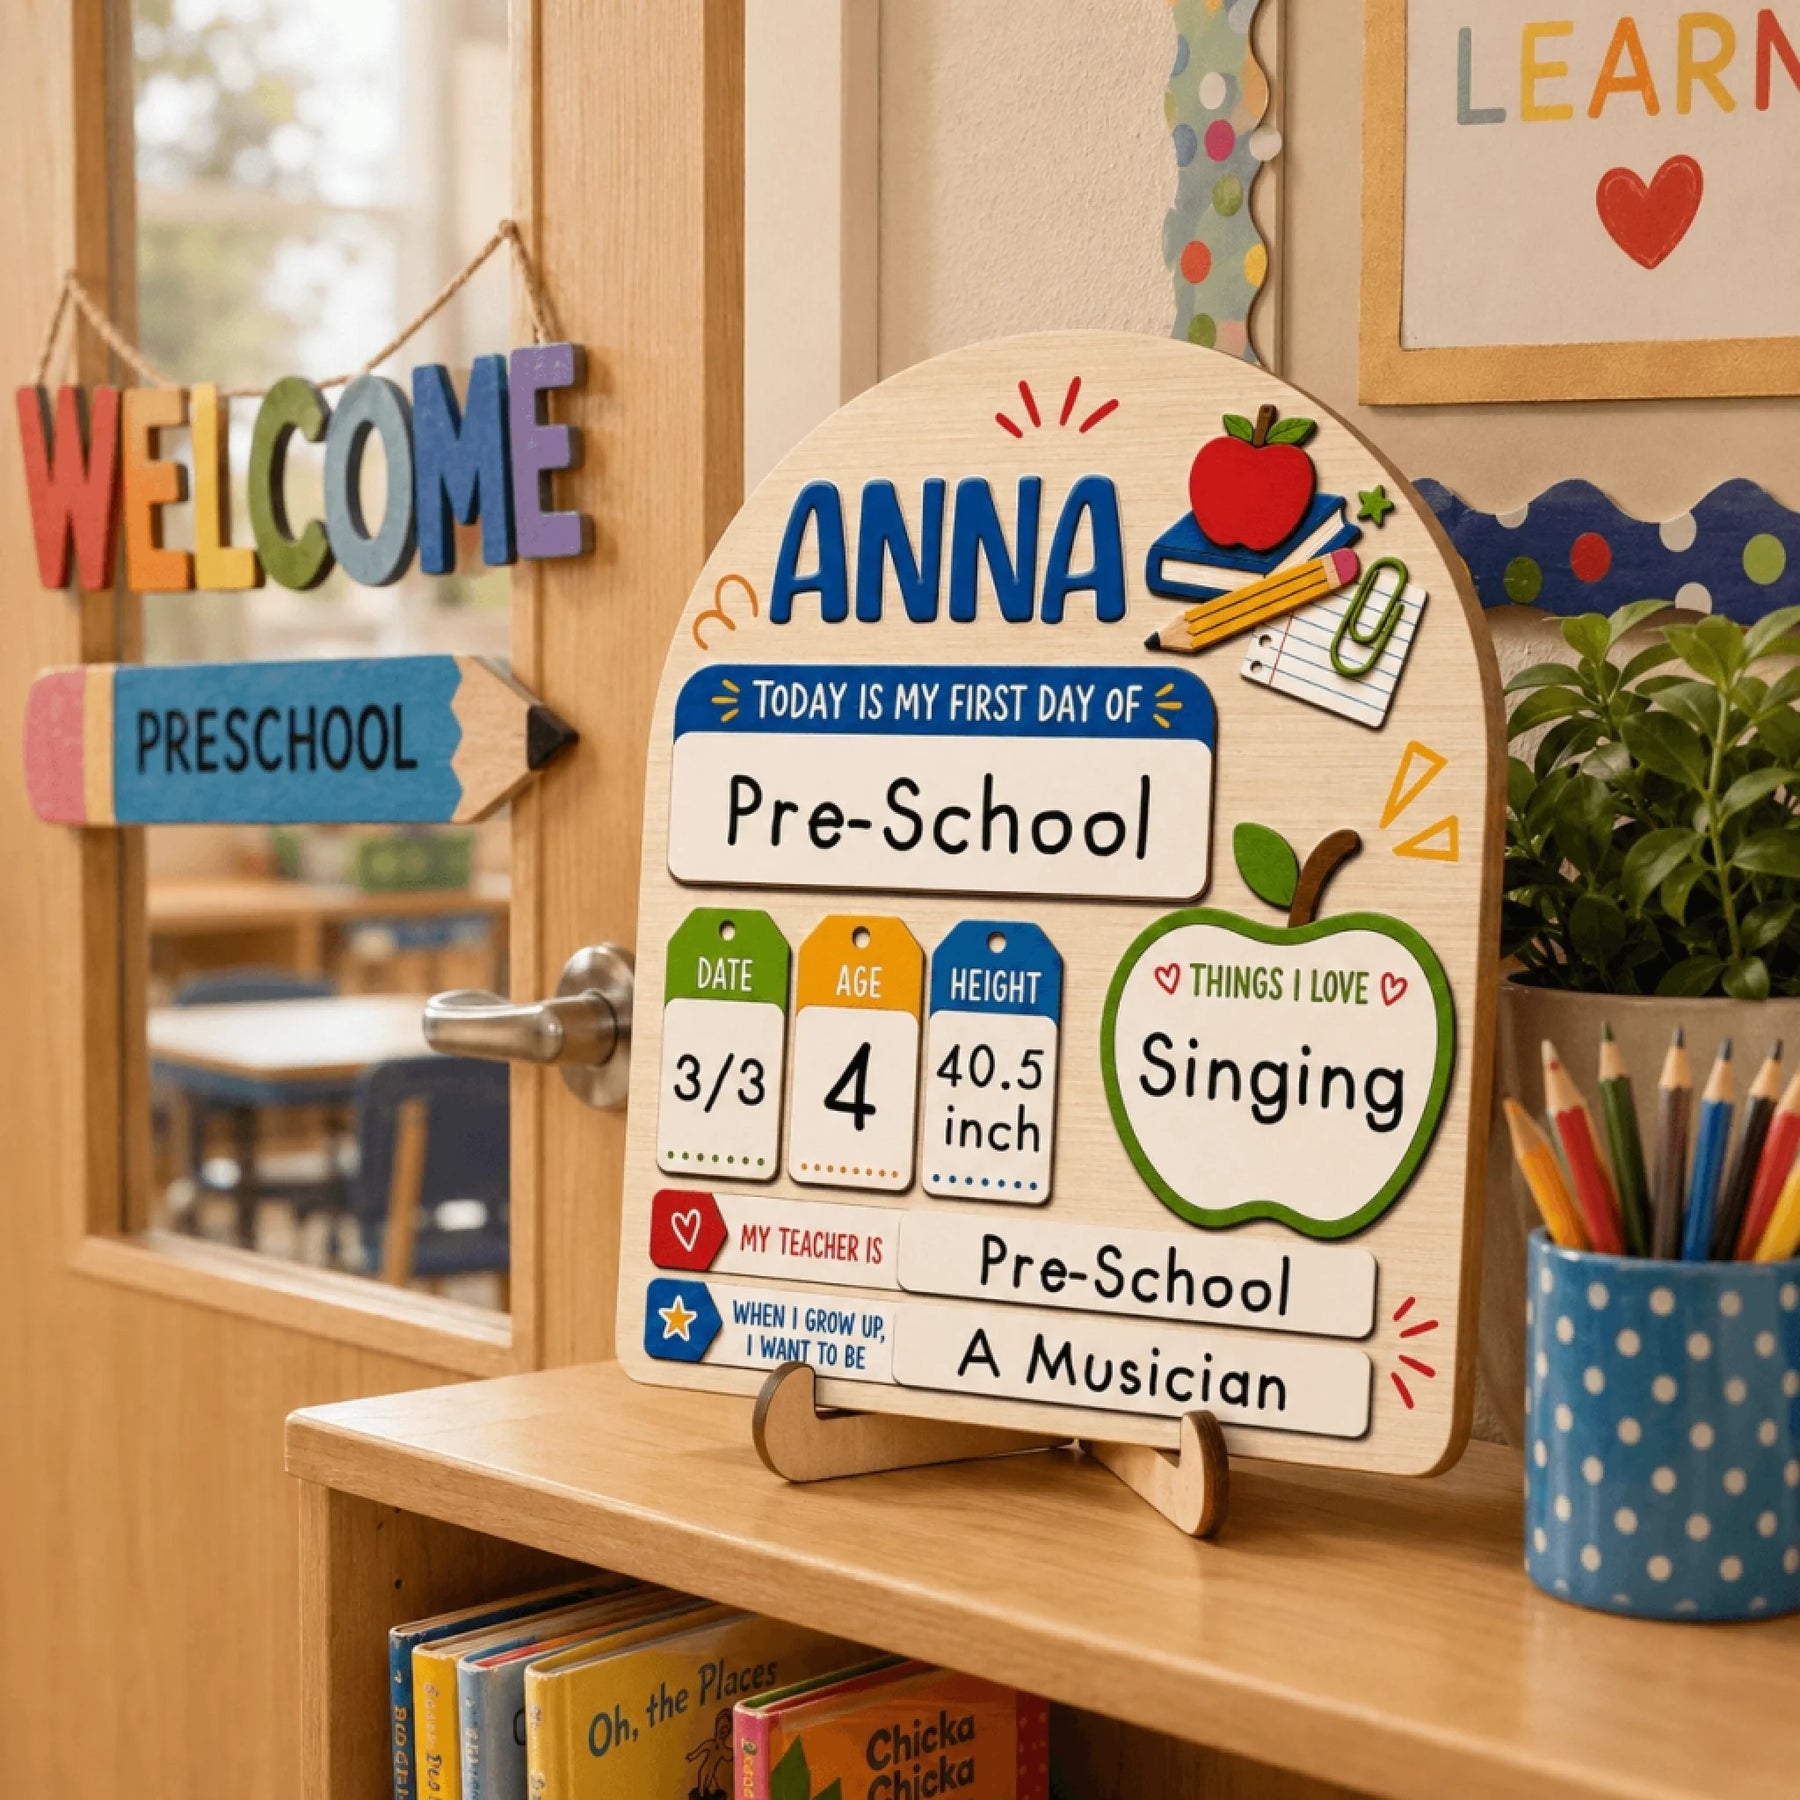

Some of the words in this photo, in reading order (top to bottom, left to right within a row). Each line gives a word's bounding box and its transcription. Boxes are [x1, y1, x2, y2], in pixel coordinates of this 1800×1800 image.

[16, 342, 594, 593] WELCOME
[769, 474, 1127, 624] ANNA
[753, 679, 847, 720] TODAY
[859, 683, 883, 719] IS
[894, 684, 939, 721] MY
[950, 686, 1027, 722] FIRST
[1038, 685, 1095, 723] DAY
[1105, 686, 1143, 723] OF
[136, 704, 418, 775] PRESCHOOL
[727, 773, 1150, 859] Pre-School
[697, 957, 753, 992] DATE
[836, 964, 883, 998] AGE
[950, 967, 1042, 1004] HEIGHT
[1189, 962, 1284, 1001] THINGS
[1293, 968, 1300, 1002] I
[1310, 969, 1370, 1005] LOVE
[673, 1053, 765, 1113] 3/3
[823, 1042, 876, 1131] 4
[936, 1044, 1044, 1091] 40.5
[1139, 1031, 1404, 1133] Singing
[945, 1104, 1040, 1152] inch
[740, 1224, 770, 1252] MY
[779, 1227, 858, 1263] TEACHER
[866, 1236, 883, 1264] IS
[980, 1233, 1290, 1316] Pre-School
[732, 1300, 785, 1329] WHEN
[792, 1308, 797, 1329] I
[804, 1308, 855, 1336] GROW
[862, 1314, 885, 1343] UP,
[747, 1334, 752, 1356] I
[761, 1335, 811, 1364] WANT
[817, 1342, 838, 1366] TO
[844, 1345, 865, 1369] BE
[957, 1328, 1001, 1378] A
[1026, 1333, 1286, 1411] Musician
[588, 1704, 639, 1758] Oh,
[646, 1682, 689, 1728] the
[697, 1659, 778, 1706] Places
[866, 1710, 976, 1770] Chicka
[867, 1755, 976, 1800] Chicka
